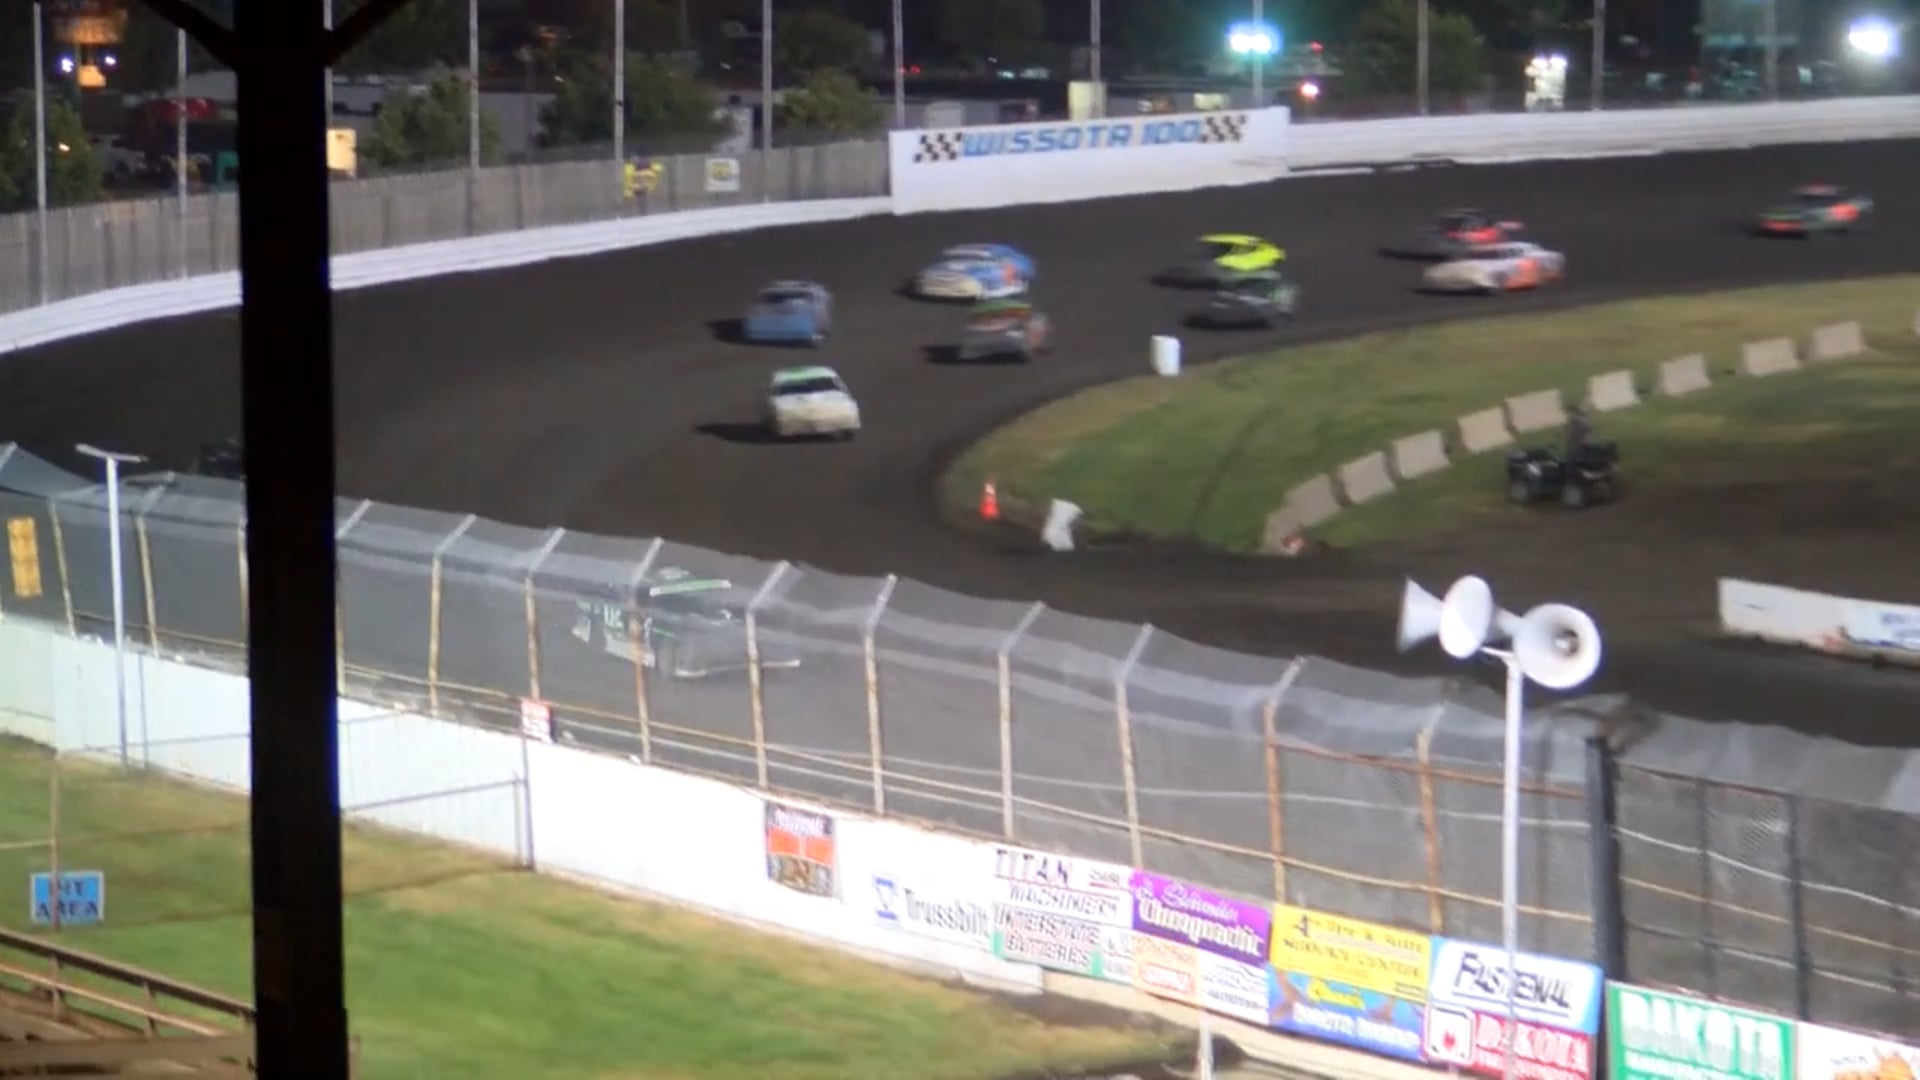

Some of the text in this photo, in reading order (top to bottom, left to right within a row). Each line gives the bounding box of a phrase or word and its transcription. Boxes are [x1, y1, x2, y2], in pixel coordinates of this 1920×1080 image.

[963, 118, 1200, 157] WISSOTA 100
[994, 849, 1073, 885] TITAN
[1009, 883, 1118, 916] MACHINERY
[993, 902, 1101, 946] INTERSTATE
[1006, 934, 1091, 966] BATTERIES
[1619, 991, 1781, 1074] DAKOTA
